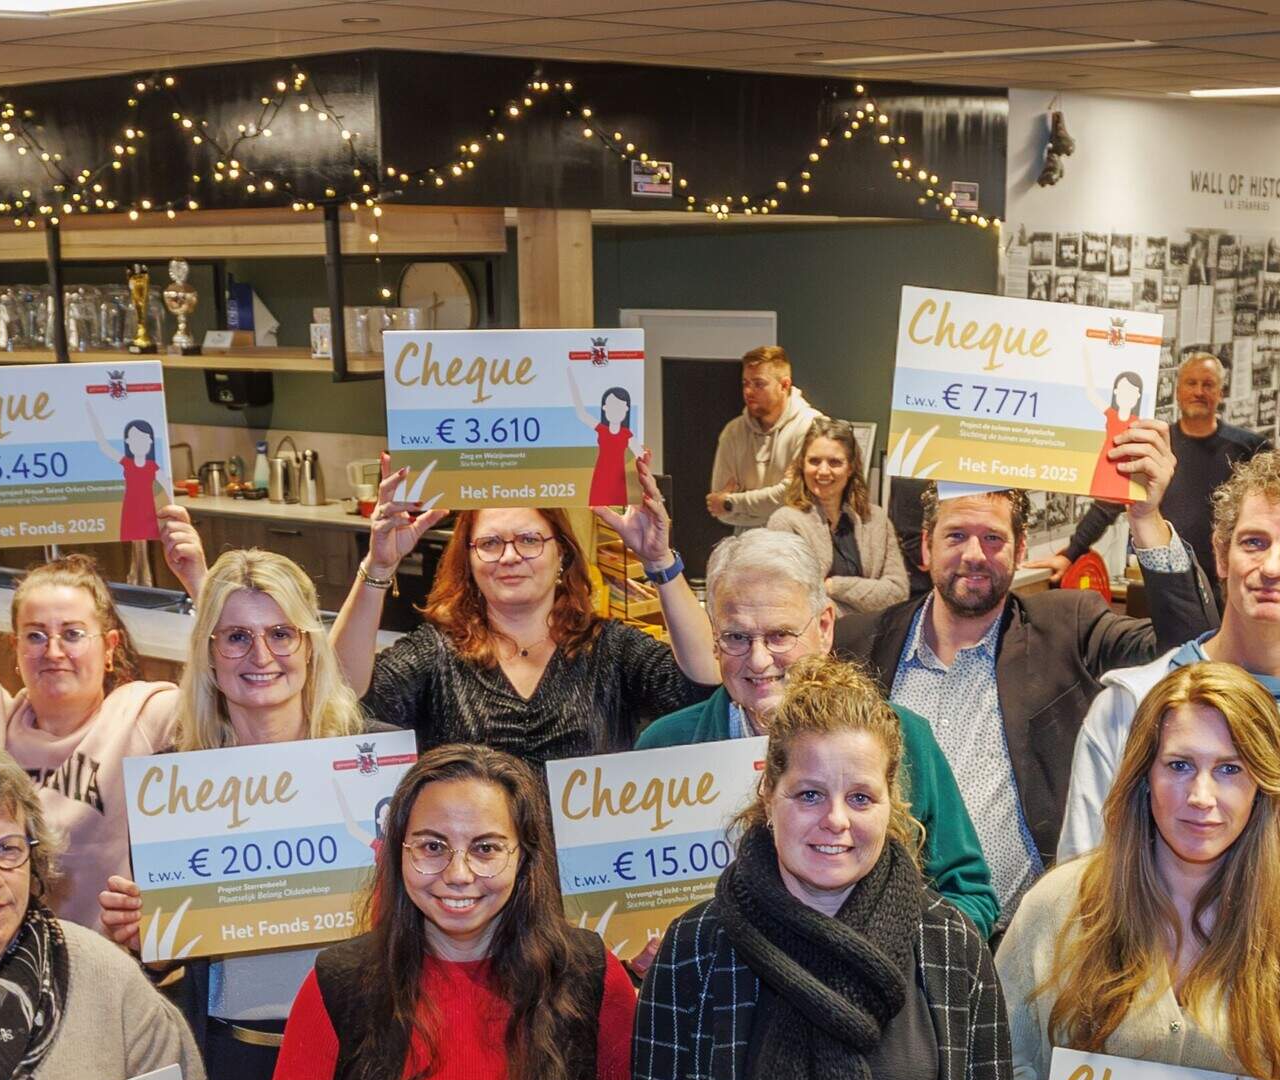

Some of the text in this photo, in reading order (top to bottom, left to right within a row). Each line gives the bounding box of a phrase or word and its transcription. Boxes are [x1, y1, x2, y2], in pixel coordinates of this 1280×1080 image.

[1190, 170, 1223, 194] WALL
[1228, 173, 1244, 195] OF
[907, 297, 1050, 373] Cheque
[393, 341, 536, 404] Cheque
[905, 383, 1038, 417] t.w.v. € 7.771
[400, 417, 540, 444] t.w.v. € 3.610
[958, 457, 1077, 481] Het Fonds 2025
[460, 483, 575, 498] Het Fonds 2025
[19, 520, 65, 535] Fonds
[68, 518, 105, 533] 2025
[135, 763, 295, 829] Cheque
[560, 767, 720, 832] Cheque
[148, 835, 337, 883] t.w.v. € 20.000
[574, 840, 729, 887] t.w.v. € 15.00
[221, 911, 354, 940] Het Fonds 2025
